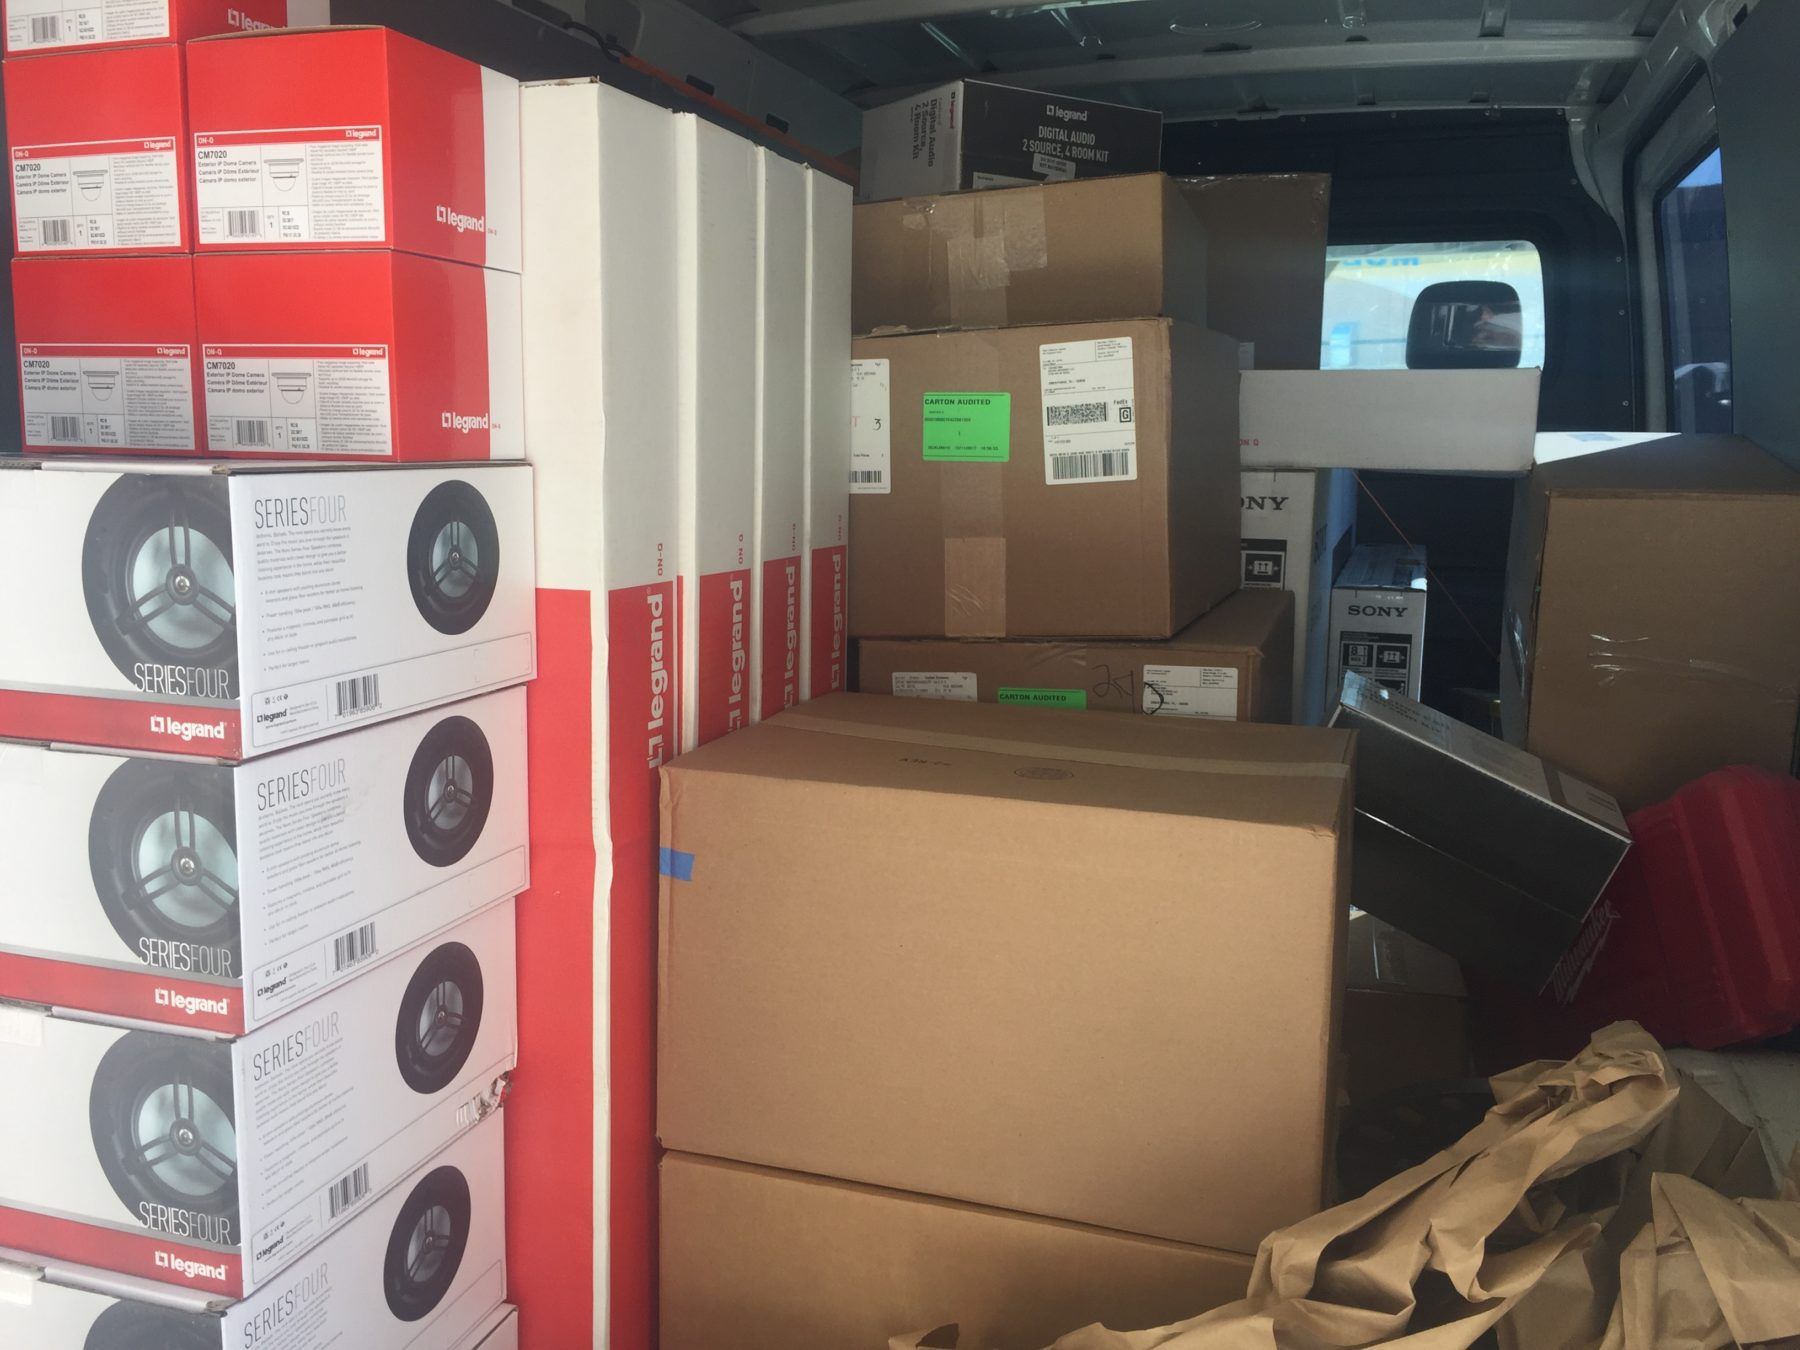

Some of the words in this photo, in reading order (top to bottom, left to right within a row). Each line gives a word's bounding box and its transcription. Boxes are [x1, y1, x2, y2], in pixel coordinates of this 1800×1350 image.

[1056, 106, 1088, 122] legrand
[352, 129, 376, 138] legrand
[1038, 126, 1069, 141] DIGITAL
[1070, 131, 1096, 146] AUDIO
[150, 140, 172, 150] legrand
[1022, 138, 1028, 151] 2
[1029, 140, 1064, 158] SOURCE,
[1064, 146, 1070, 157] 4
[1072, 147, 1094, 161] ROOM
[1096, 150, 1109, 162] KIT
[198, 150, 227, 159] CM7020
[15, 163, 41, 172] CM7020
[447, 211, 484, 233] legrand
[163, 347, 185, 356] legrand
[358, 348, 384, 357] legrand
[452, 412, 488, 433] legrand
[1122, 410, 1129, 420] G
[1241, 496, 1289, 512] NY
[832, 554, 843, 658] legrand
[1348, 604, 1408, 618] SONY
[784, 566, 798, 680] legrand
[728, 580, 746, 704] legrand
[647, 593, 668, 731] legrand
[999, 693, 1029, 702] CARTON
[1032, 694, 1067, 703] AUDITED
[264, 709, 287, 722] legrand
[167, 716, 225, 741] legrand
[263, 977, 287, 995] legrand
[171, 990, 228, 1016] legrand
[170, 1254, 226, 1280] legrand
